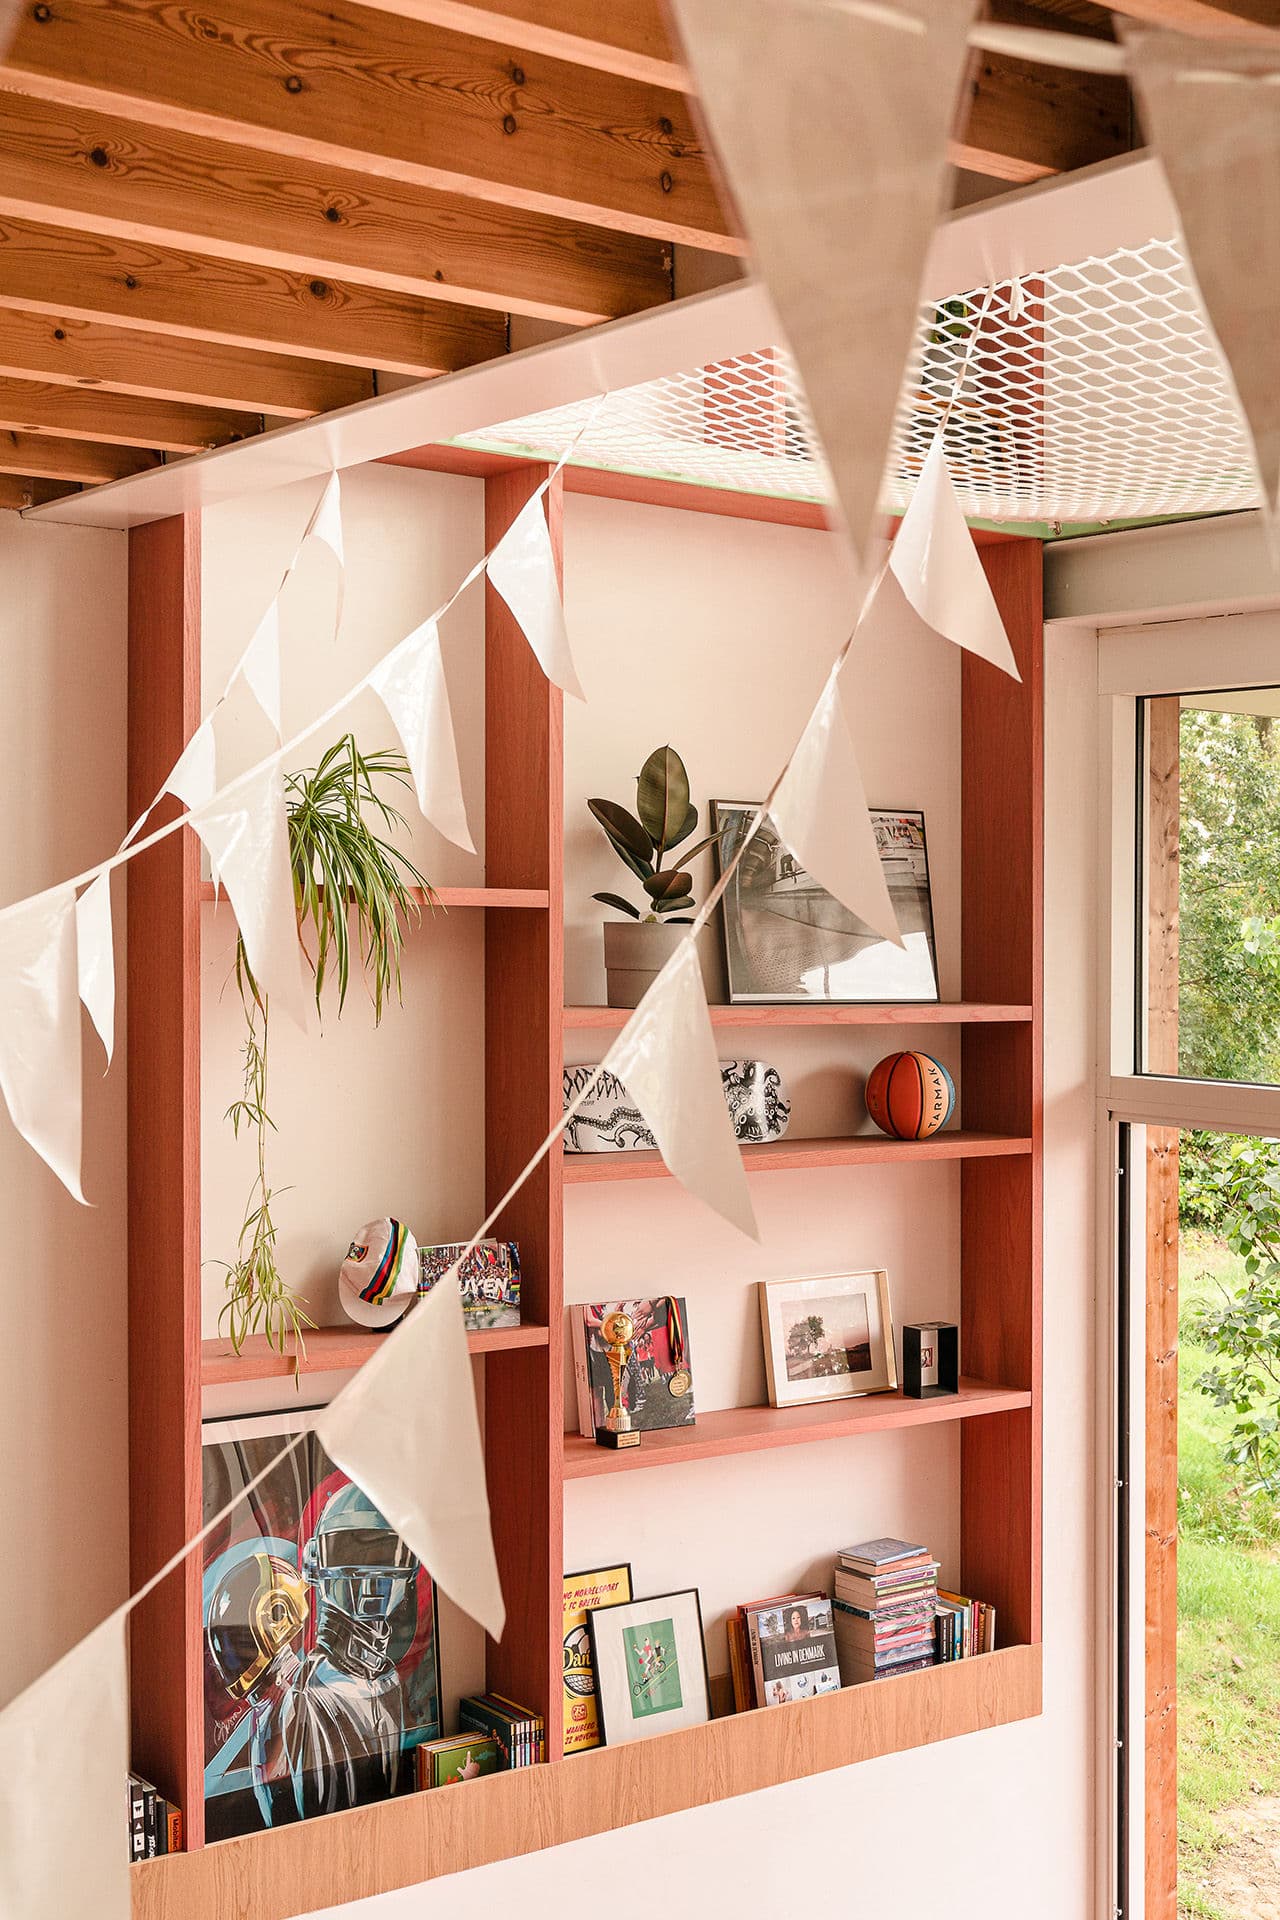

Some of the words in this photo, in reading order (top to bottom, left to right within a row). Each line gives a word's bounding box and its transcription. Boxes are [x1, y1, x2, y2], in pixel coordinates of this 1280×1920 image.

[927, 1067, 943, 1129] TARMAK
[774, 1650, 793, 1667] LIVING
[792, 1648, 800, 1663] IN
[799, 1644, 826, 1662] DENMARK
